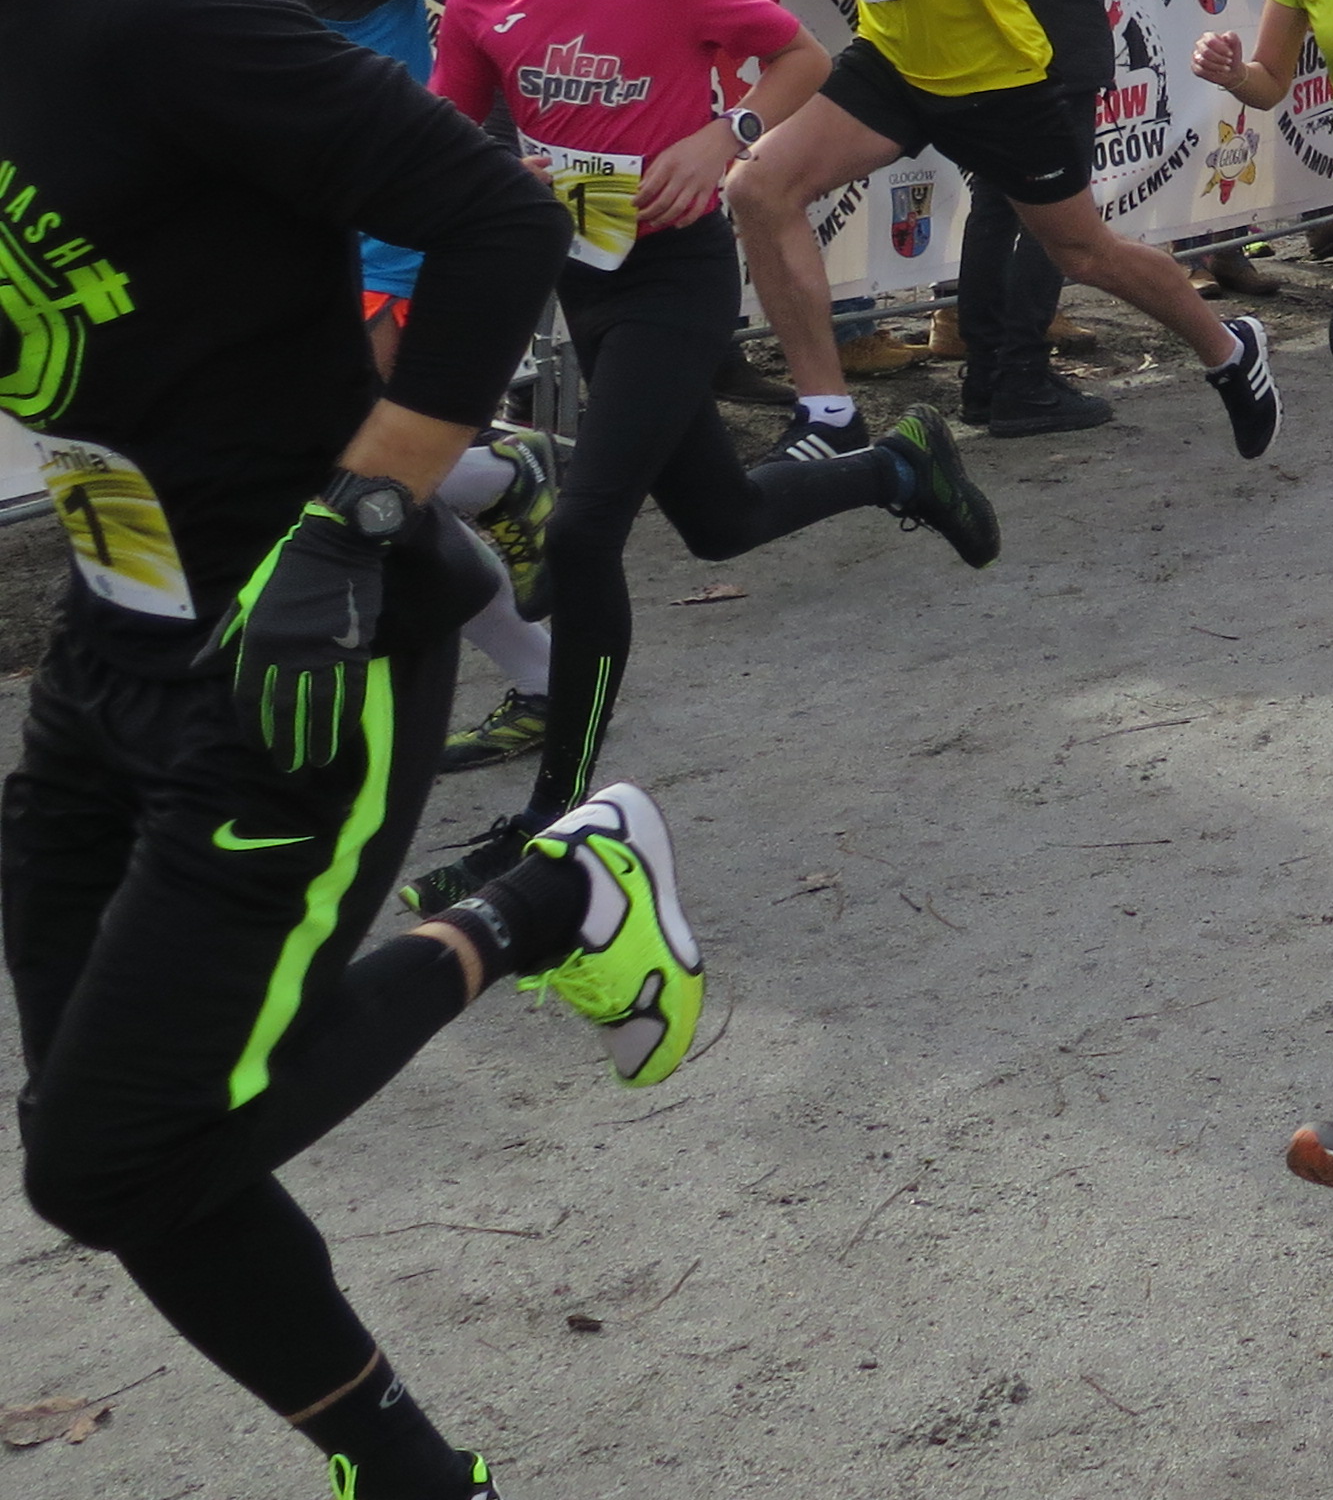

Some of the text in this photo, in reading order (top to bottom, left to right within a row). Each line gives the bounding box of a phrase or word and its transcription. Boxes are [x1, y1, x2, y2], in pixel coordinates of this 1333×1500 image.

[545, 34, 621, 80] Neo
[1277, 110, 1305, 156] MAN
[1118, 128, 1200, 216] ELEMENTS
